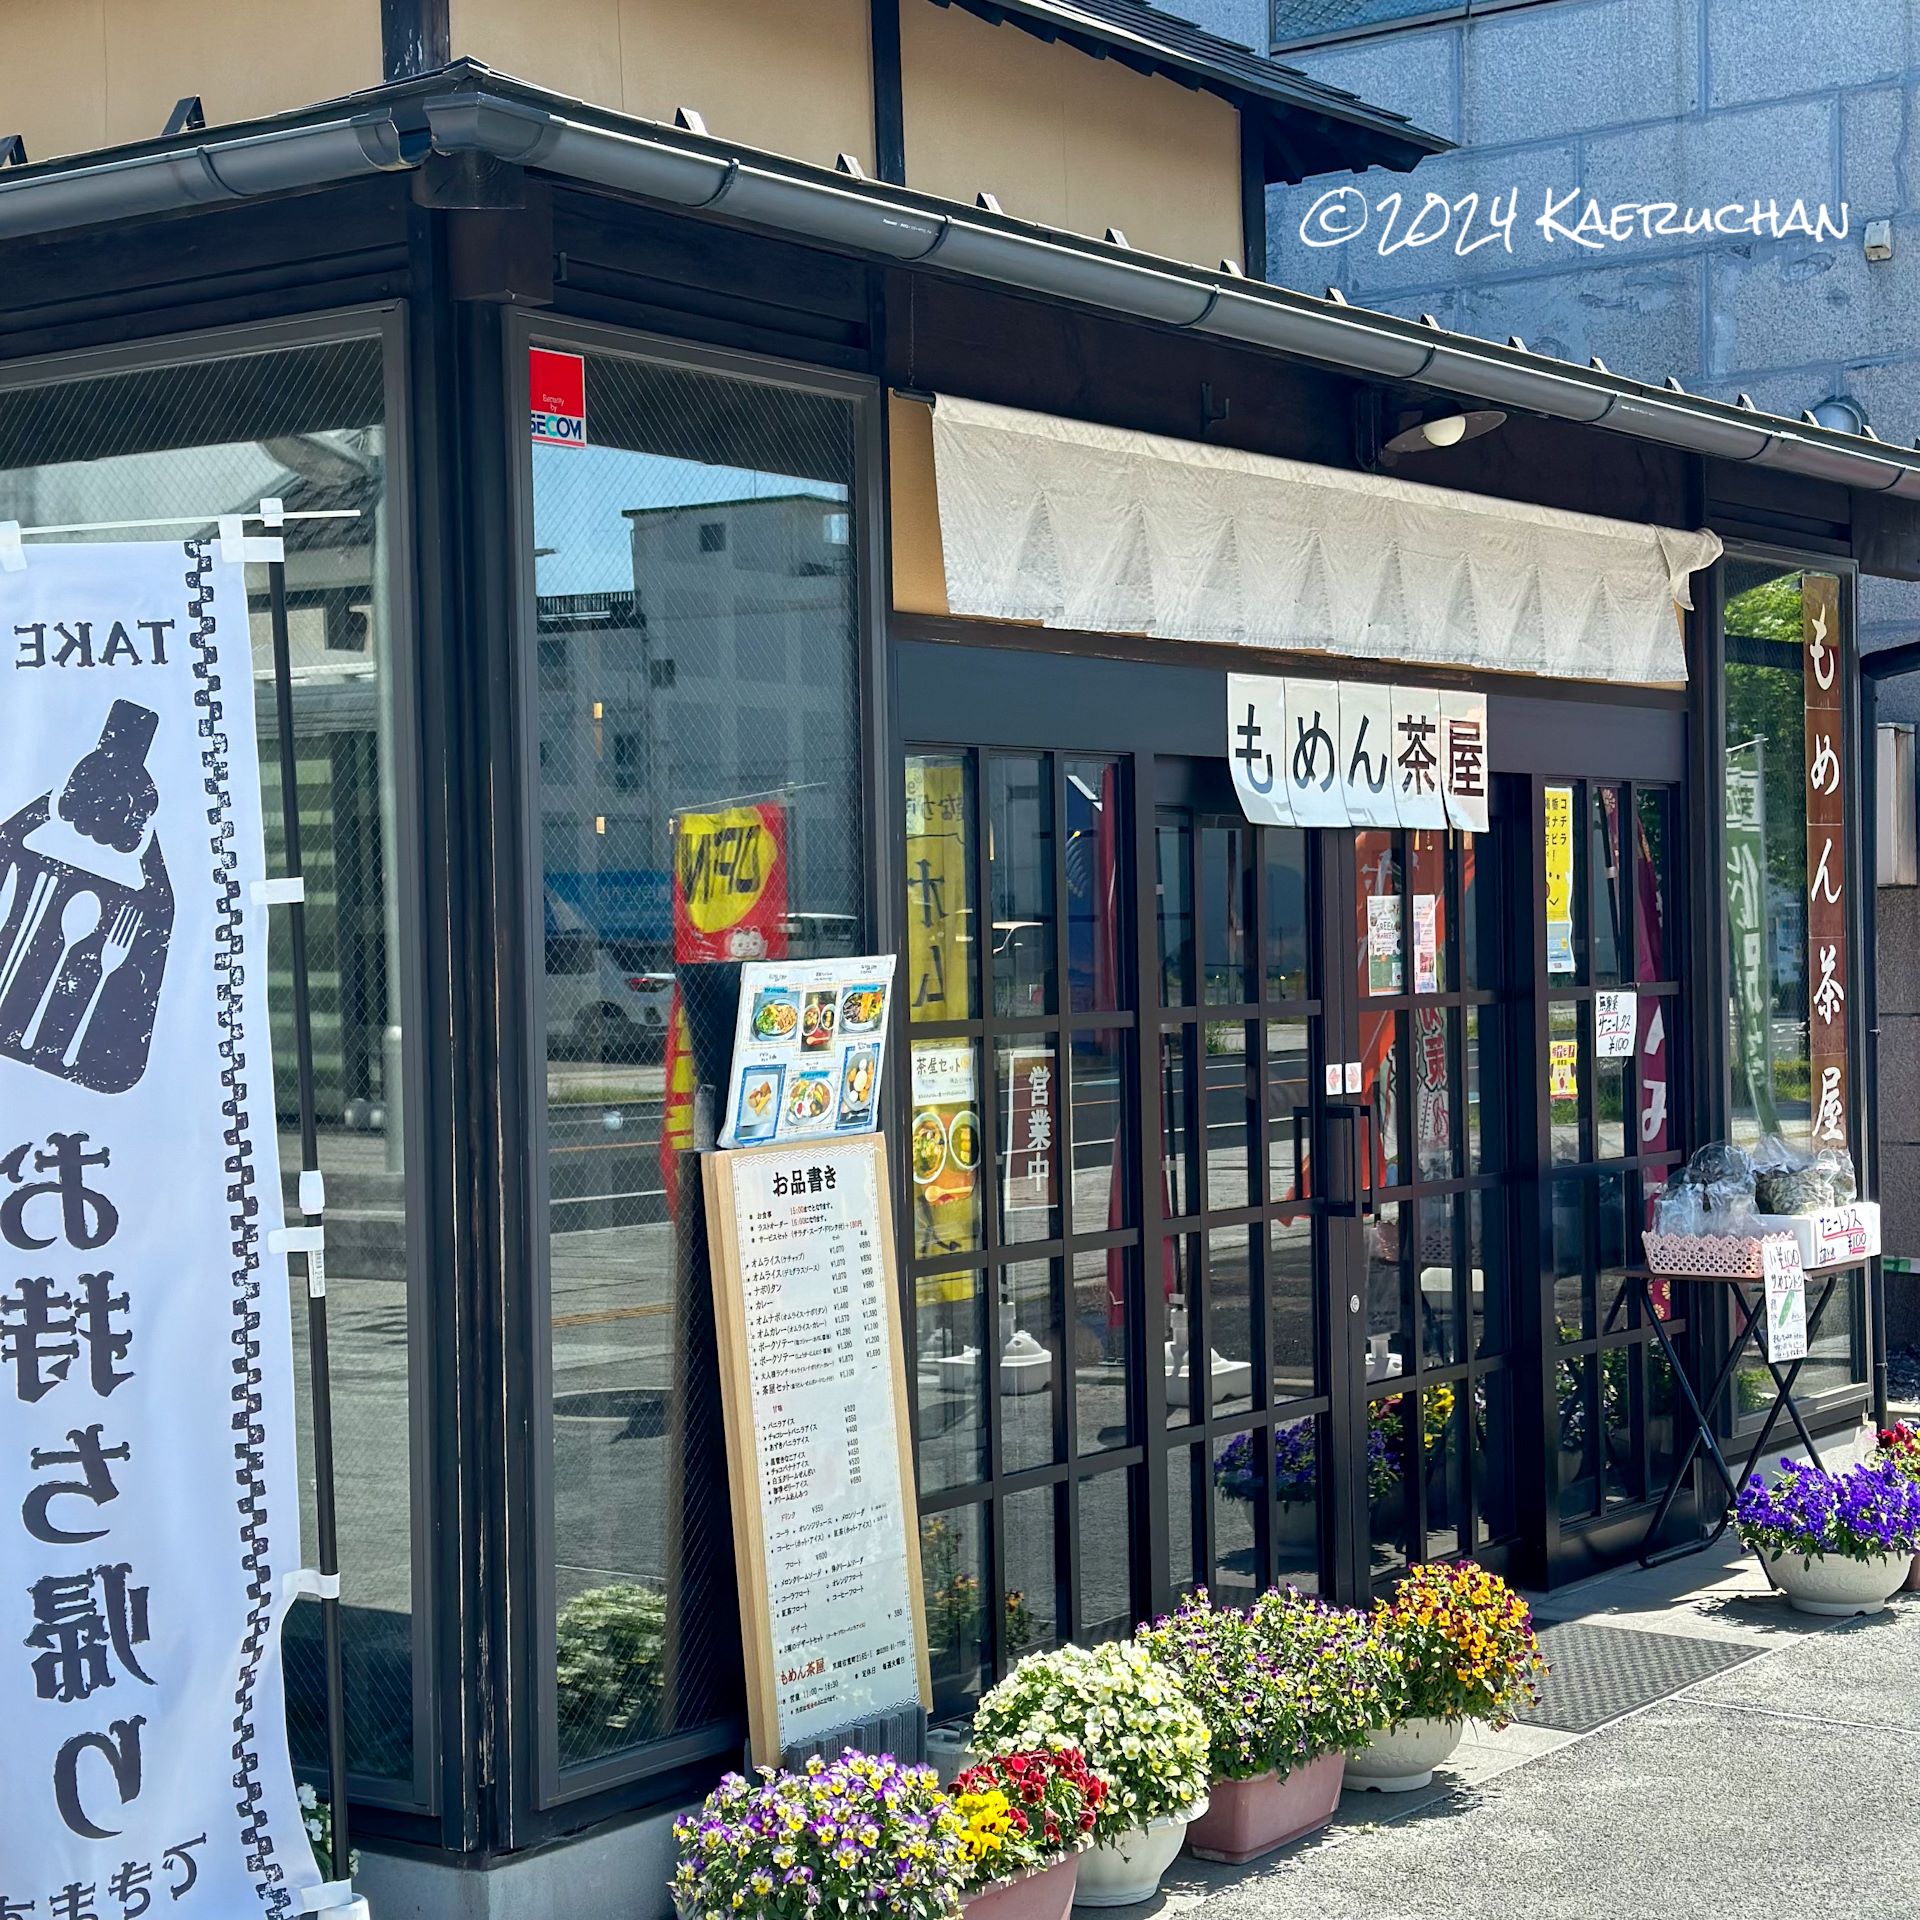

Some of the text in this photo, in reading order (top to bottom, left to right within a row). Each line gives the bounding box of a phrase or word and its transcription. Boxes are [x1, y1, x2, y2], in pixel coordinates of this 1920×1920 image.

[1235, 703, 1485, 797] もめん茶屋
[1808, 604, 1845, 1141] もめん茶屋
[916, 1056, 961, 1075] 茶屋セット
[1027, 1065, 1051, 1192] 営業中
[772, 1164, 837, 1197] お品書き
[753, 1283, 781, 1295] ナポリタン
[754, 1300, 773, 1310] カレー
[780, 1657, 825, 1685] もめん茶屋
